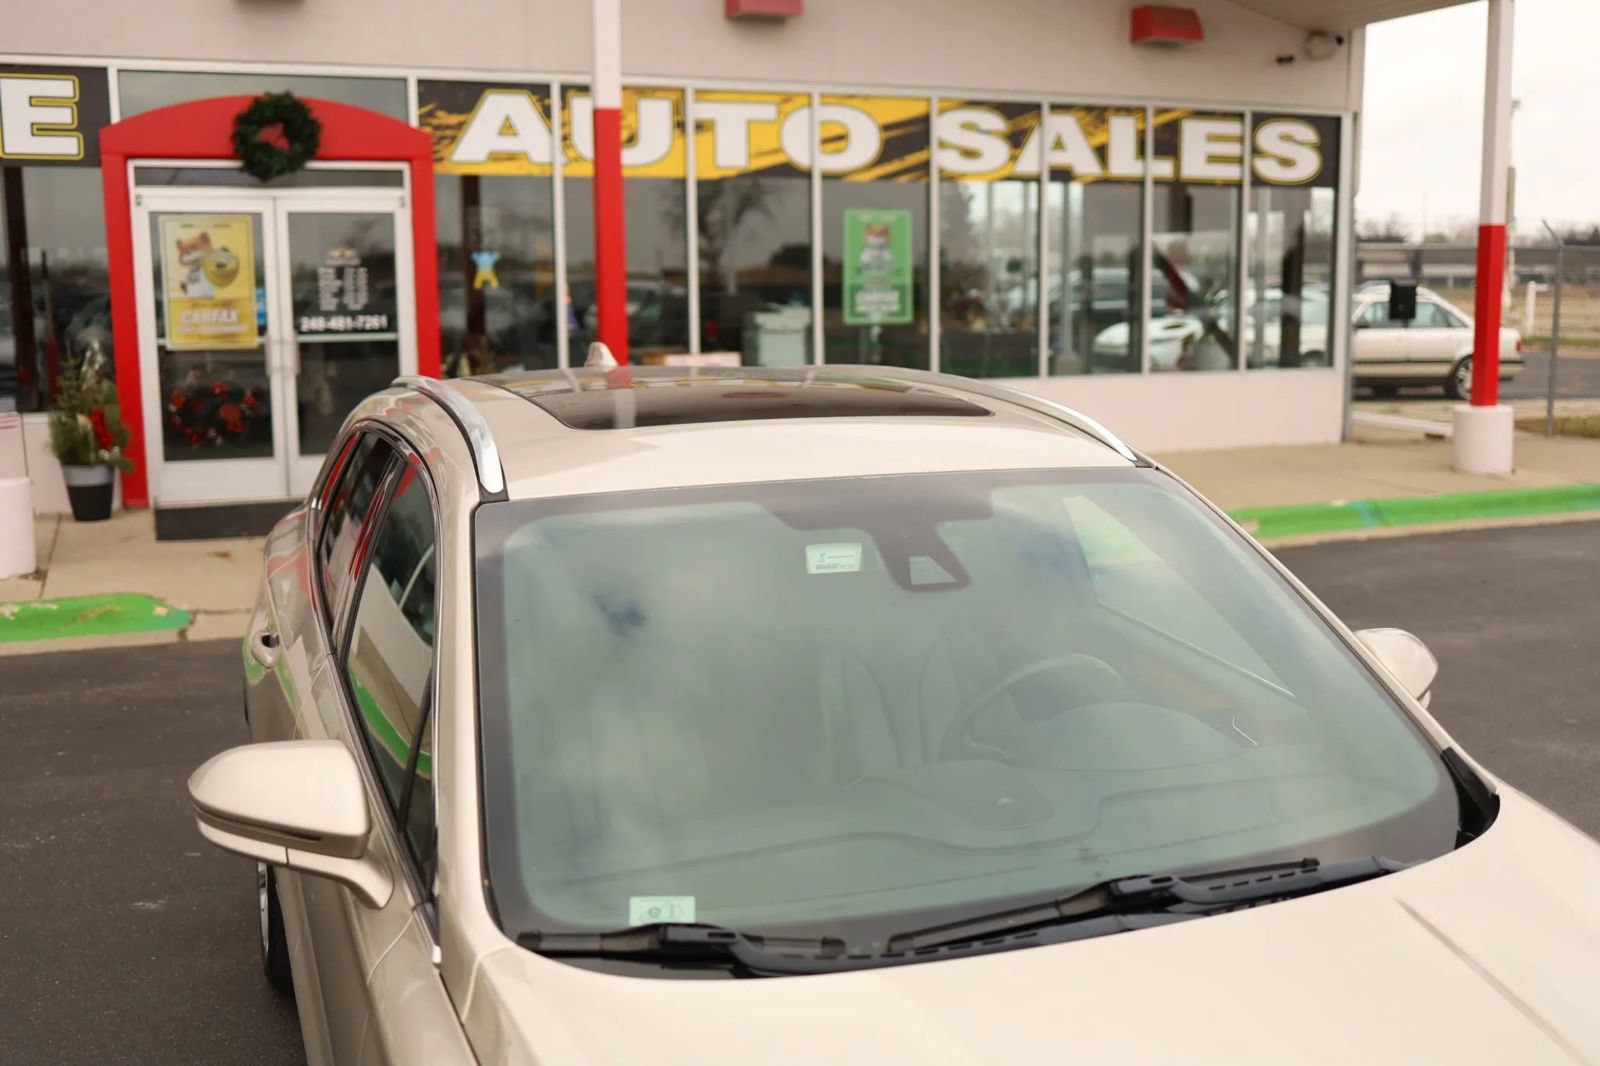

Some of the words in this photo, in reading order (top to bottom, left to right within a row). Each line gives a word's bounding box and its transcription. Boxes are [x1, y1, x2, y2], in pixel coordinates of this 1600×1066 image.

[0, 73, 84, 160] E
[450, 88, 885, 173] AUTO
[935, 106, 1323, 185] SALES
